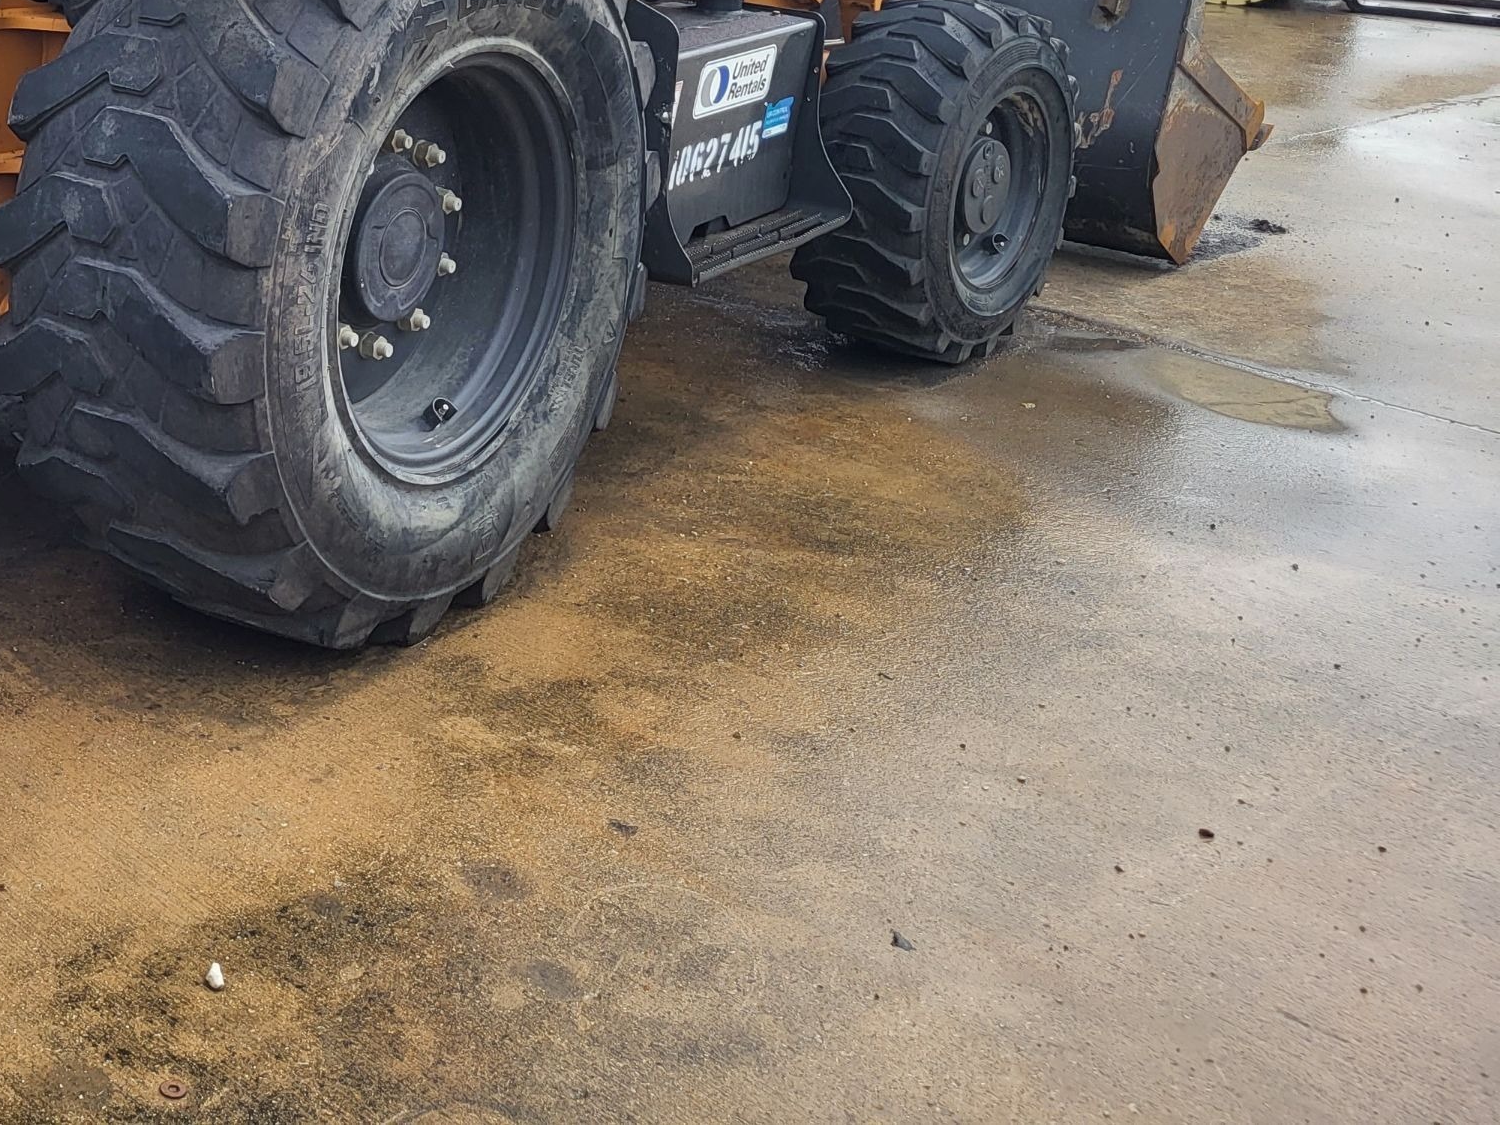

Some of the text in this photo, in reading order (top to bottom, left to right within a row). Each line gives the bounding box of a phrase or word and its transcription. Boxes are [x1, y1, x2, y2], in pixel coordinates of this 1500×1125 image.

[731, 53, 770, 81] United
[726, 75, 767, 102] Rentals
[668, 120, 763, 191] 10627415
